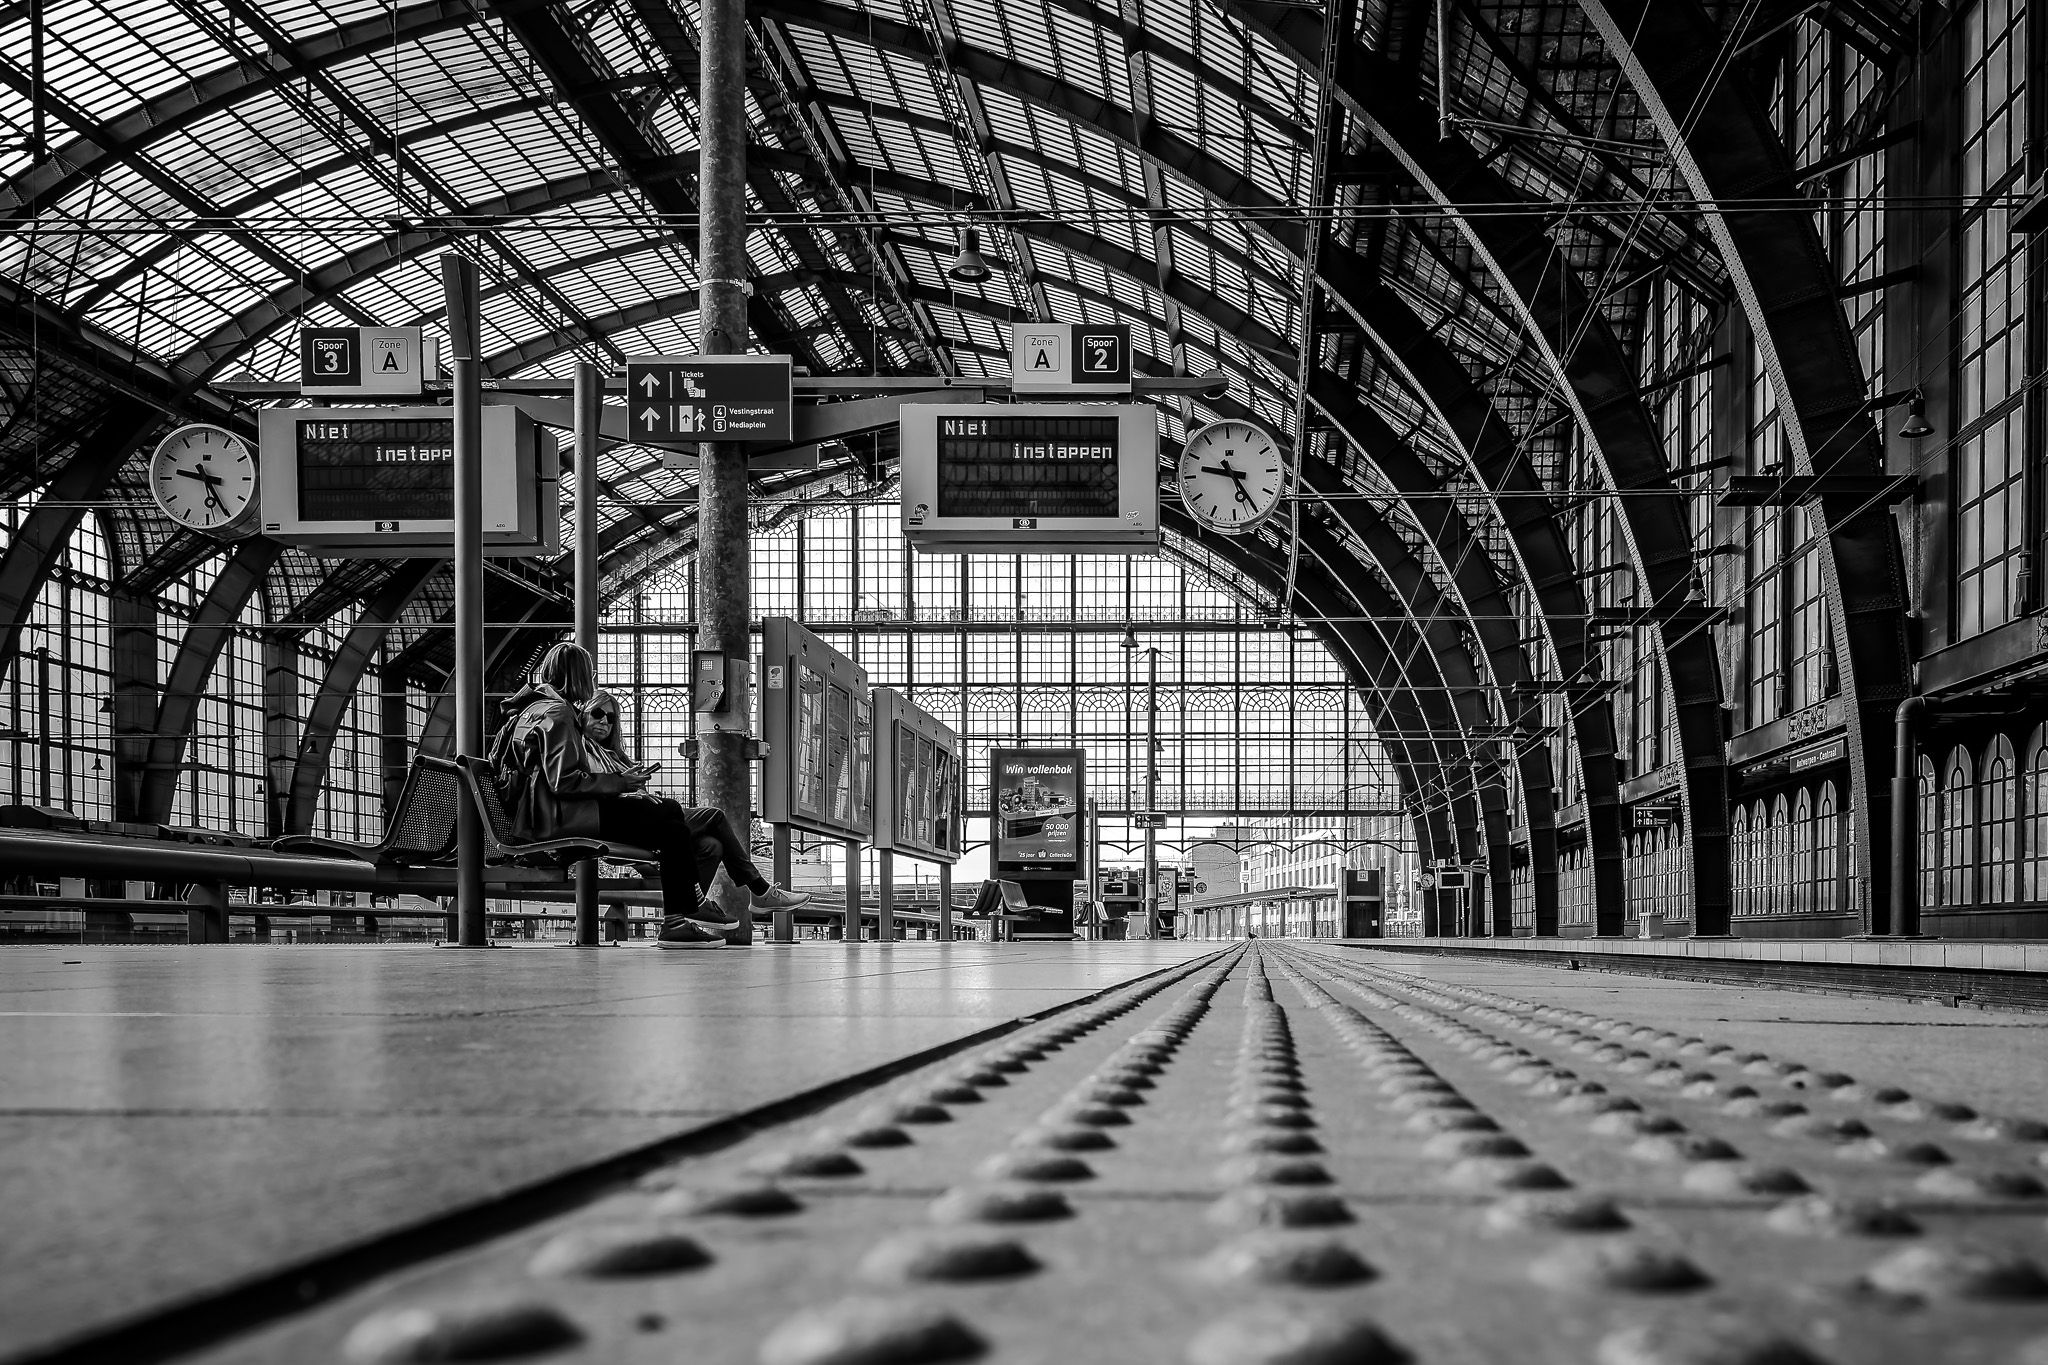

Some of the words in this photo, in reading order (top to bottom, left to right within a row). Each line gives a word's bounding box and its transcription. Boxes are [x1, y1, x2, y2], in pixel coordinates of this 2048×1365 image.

[317, 341, 344, 351] Spoor
[379, 341, 401, 349] Zone
[1031, 337, 1053, 346] Zone
[1087, 338, 1114, 348] Spoor
[324, 351, 338, 371] 3
[382, 351, 399, 371] A
[1034, 348, 1051, 368] A
[1094, 348, 1108, 369] 2
[716, 407, 723, 416] 4
[729, 408, 775, 416] Vestingstraat
[306, 423, 348, 439] Niet
[717, 421, 723, 430] 5
[729, 421, 766, 430] Mediaplein
[945, 420, 987, 435] Niet
[376, 446, 452, 462] instapp
[1014, 443, 1112, 459] instappen
[1796, 755, 1817, 768] Antwerpen
[1820, 746, 1837, 761] Centraal
[1006, 764, 1024, 774] Win
[1027, 764, 1073, 774] vollenbak
[1047, 830, 1067, 838] prijzen
